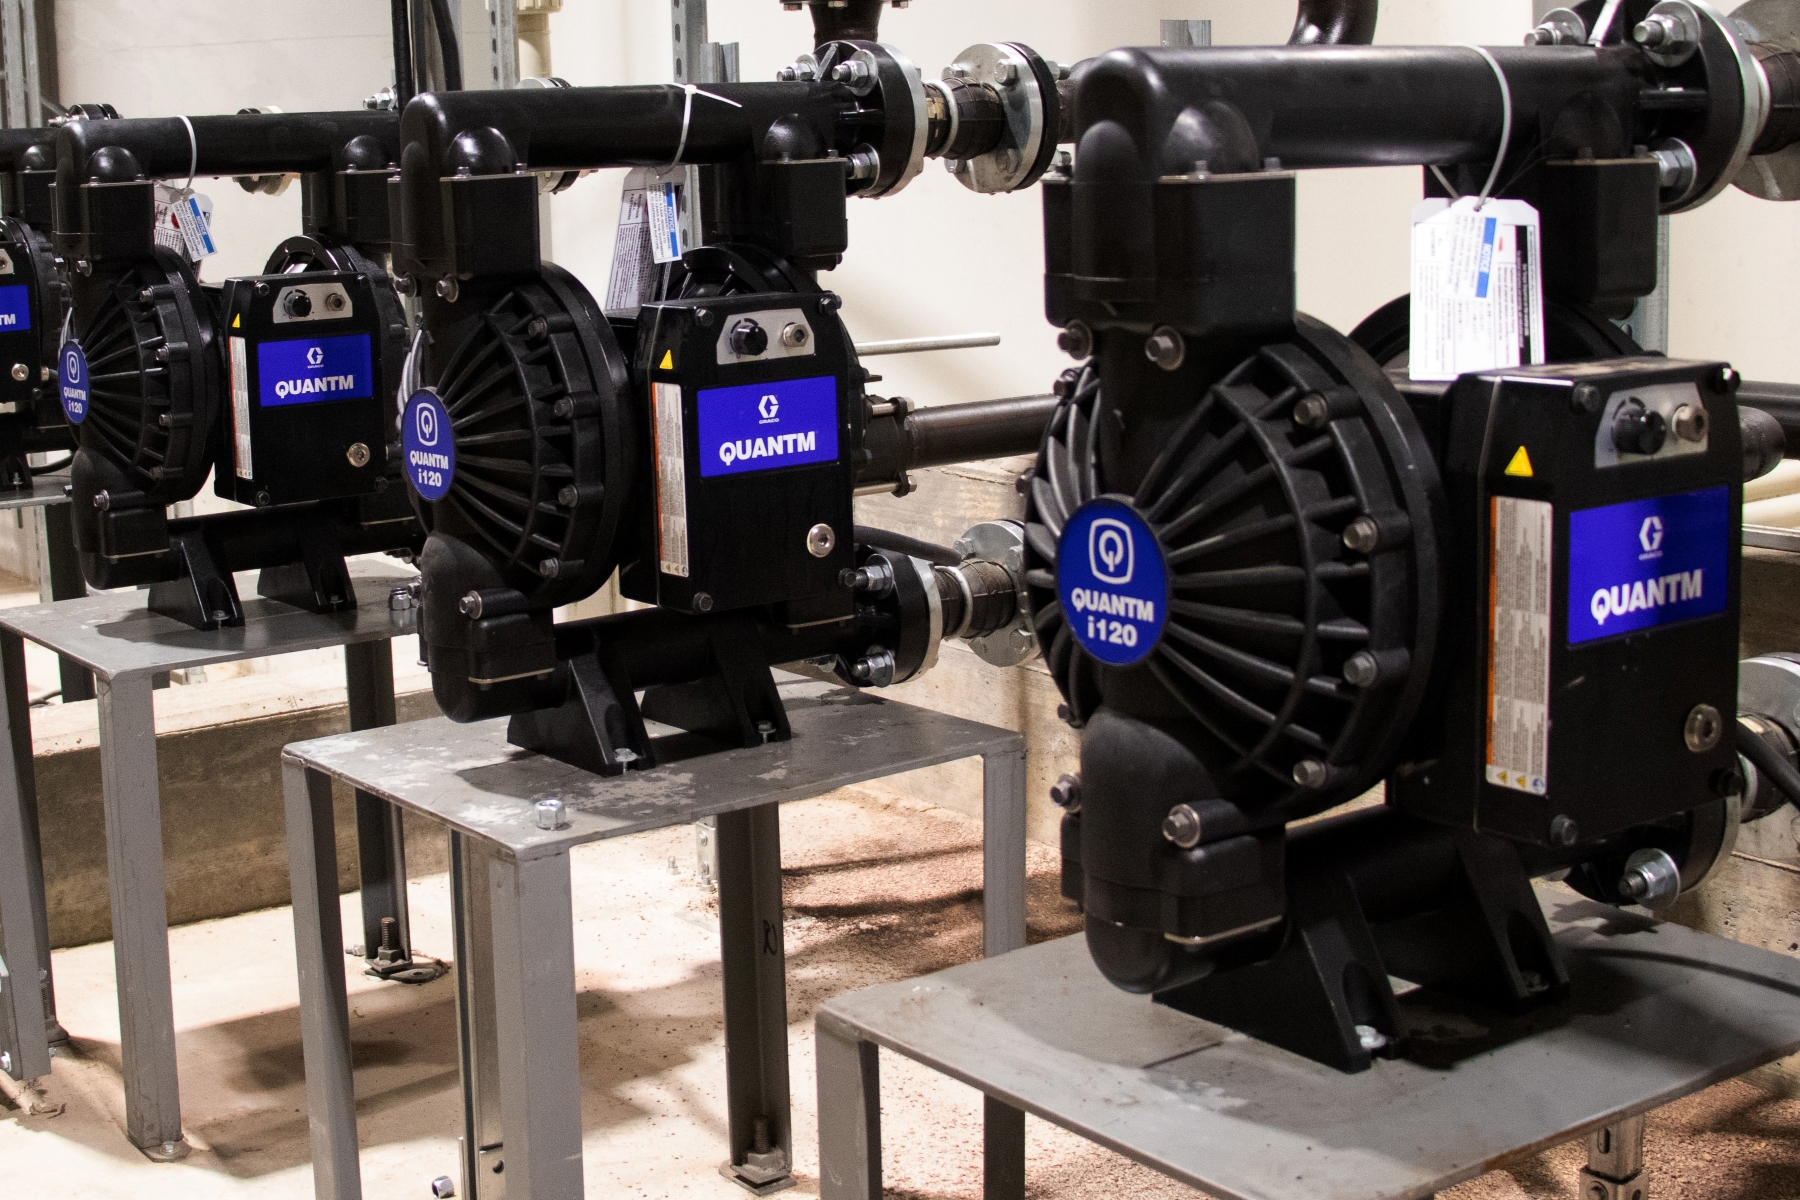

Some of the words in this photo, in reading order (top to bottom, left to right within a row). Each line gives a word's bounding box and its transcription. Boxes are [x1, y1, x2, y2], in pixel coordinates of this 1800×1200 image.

[195, 214, 207, 236] NOTICE
[1479, 243, 1492, 272] NOTICE
[64, 386, 86, 400] QUANTM
[275, 374, 354, 399] QUANTM
[68, 400, 82, 414] i120
[410, 450, 449, 470] QUANTM
[719, 431, 816, 466] QUANTM
[418, 468, 442, 487] i120
[1071, 587, 1155, 623] QUANTM
[1590, 568, 1703, 625] QUANTM
[1087, 616, 1137, 647] i120
